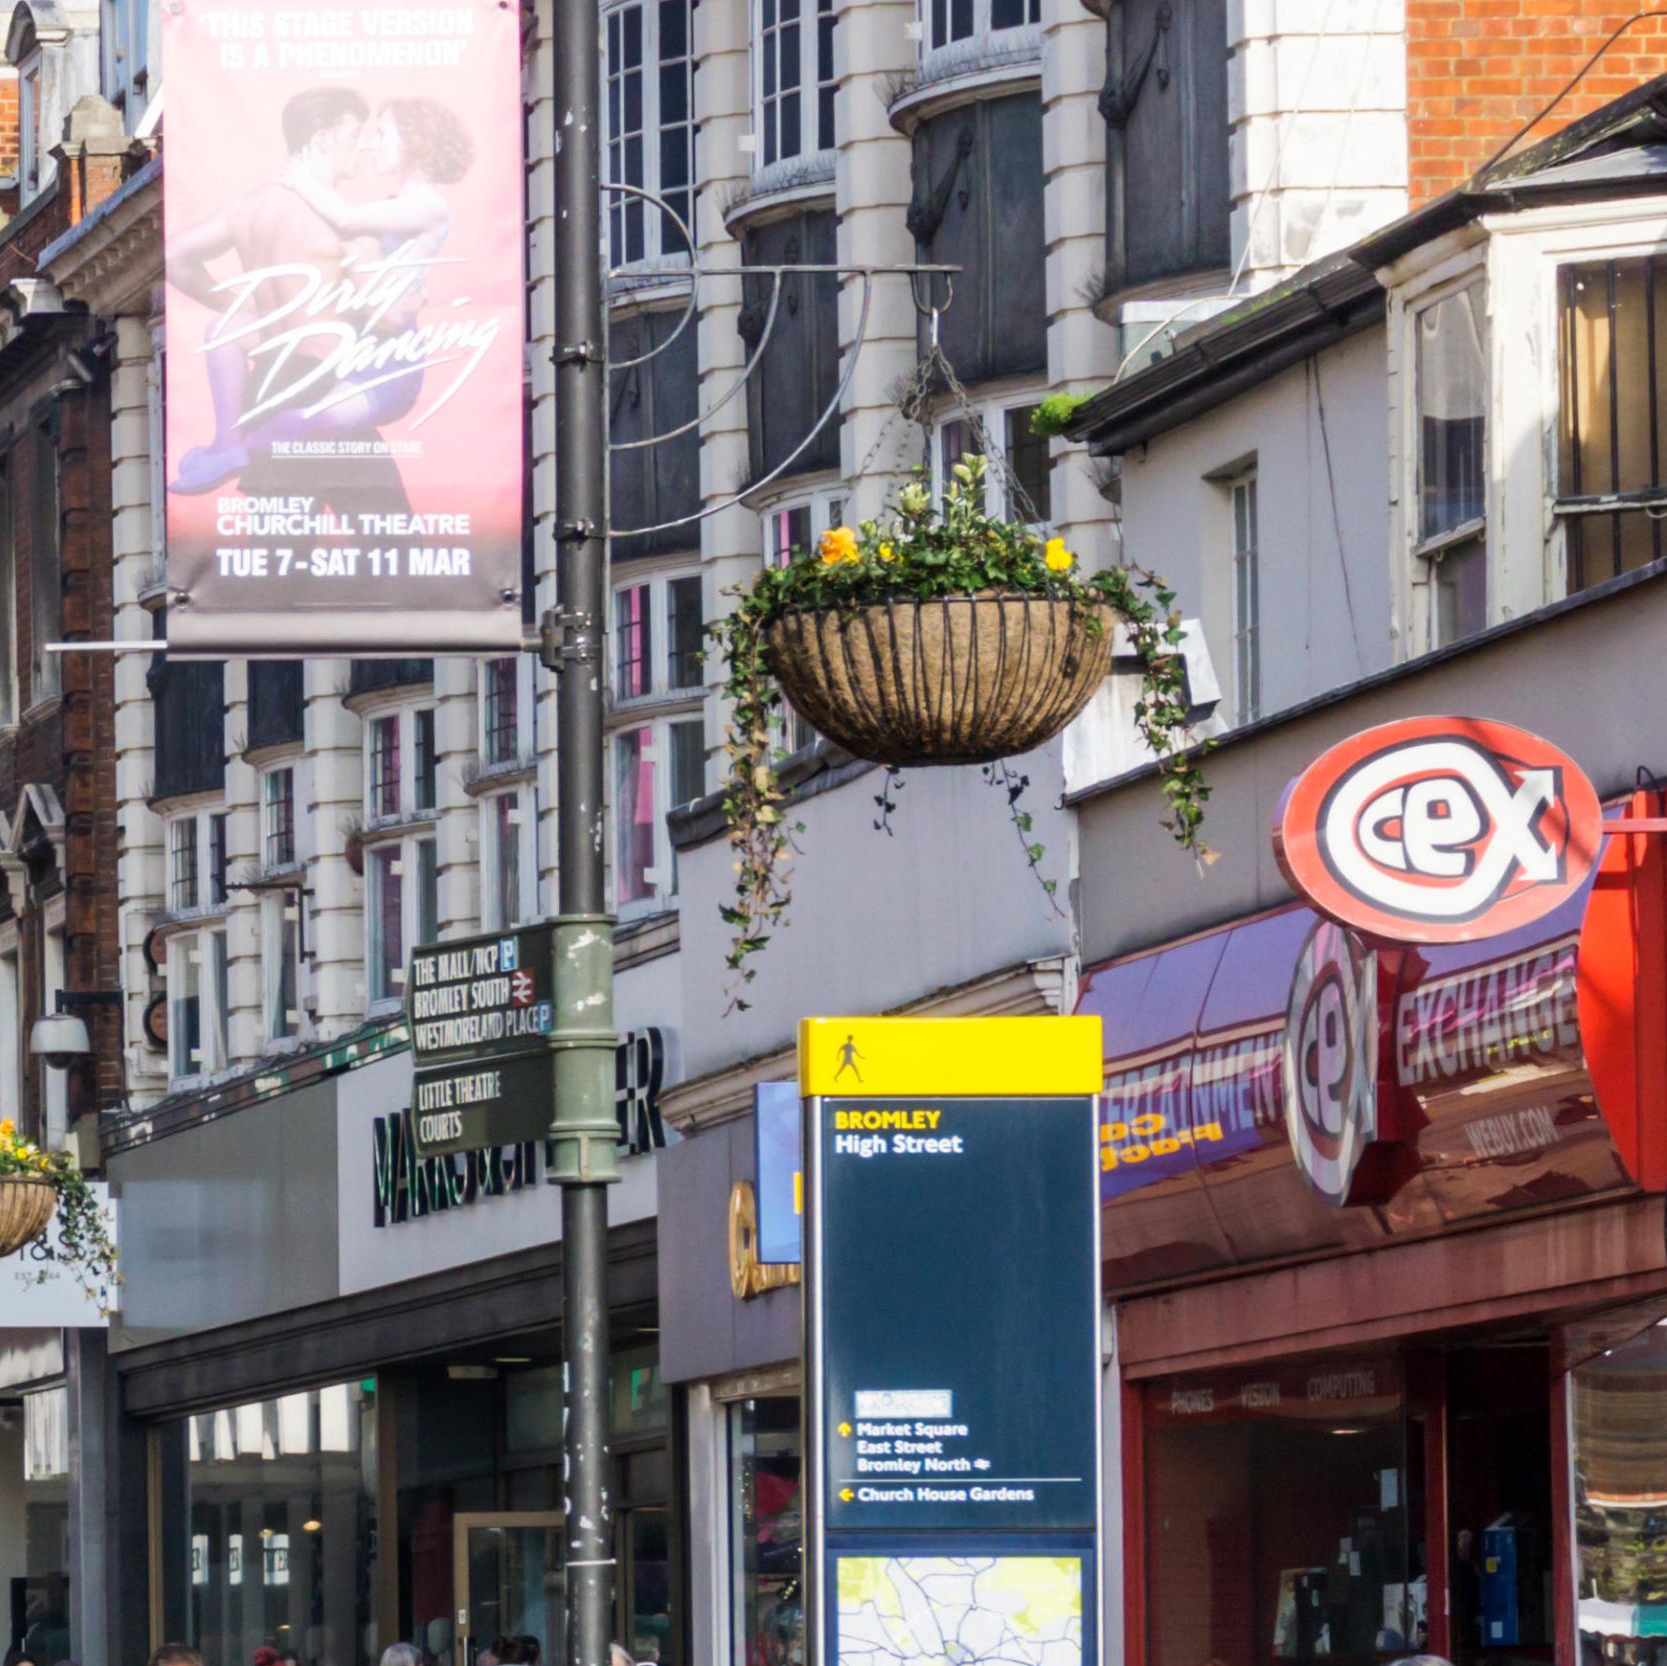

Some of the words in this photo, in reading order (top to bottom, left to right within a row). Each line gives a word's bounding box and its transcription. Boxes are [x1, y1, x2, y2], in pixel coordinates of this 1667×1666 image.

[273, 10, 355, 37] STAGE
[361, 8, 475, 36] VERSION
[220, 42, 245, 68] IS
[253, 42, 271, 68] A
[197, 240, 468, 353] Dirty
[230, 297, 502, 432] Dancing
[271, 441, 291, 455] THE
[292, 441, 336, 455] CLASSIC
[338, 441, 372, 455] STORY
[373, 441, 389, 455] ON
[217, 496, 315, 513] BROMLEY
[217, 514, 354, 536] CHURCHILL
[358, 513, 471, 535] THEATRE
[217, 550, 269, 578] TUE
[370, 548, 400, 576] 11
[408, 548, 471, 576] MAR
[414, 957, 436, 986] THE
[438, 946, 499, 983] MALL/NCP
[415, 985, 469, 1019] BROMLEY
[471, 977, 511, 1010] SOUTH
[416, 1014, 503, 1051] WESTMORELAND
[505, 1009, 538, 1037] PLACE
[419, 1080, 454, 1111] LITTLE
[455, 1071, 501, 1104] THEATRE
[419, 1112, 462, 1143] COURTS
[835, 1110, 941, 1130] BROMLEY
[1466, 1106, 1560, 1159] WEBUY.COM
[835, 1134, 887, 1158] High
[892, 1134, 964, 1154] Street
[1170, 1388, 1215, 1416] PHONES
[1240, 1381, 1281, 1409] VISION
[1306, 1370, 1376, 1400] COMPUTING
[856, 1422, 912, 1437] Market
[914, 1422, 969, 1439] Square
[856, 1440, 892, 1455] East
[894, 1440, 943, 1455] Street
[856, 1458, 922, 1475] Bromley
[924, 1458, 971, 1472] North
[857, 1487, 915, 1502] Church
[917, 1487, 967, 1501] House
[969, 1486, 1035, 1501] Gardens
